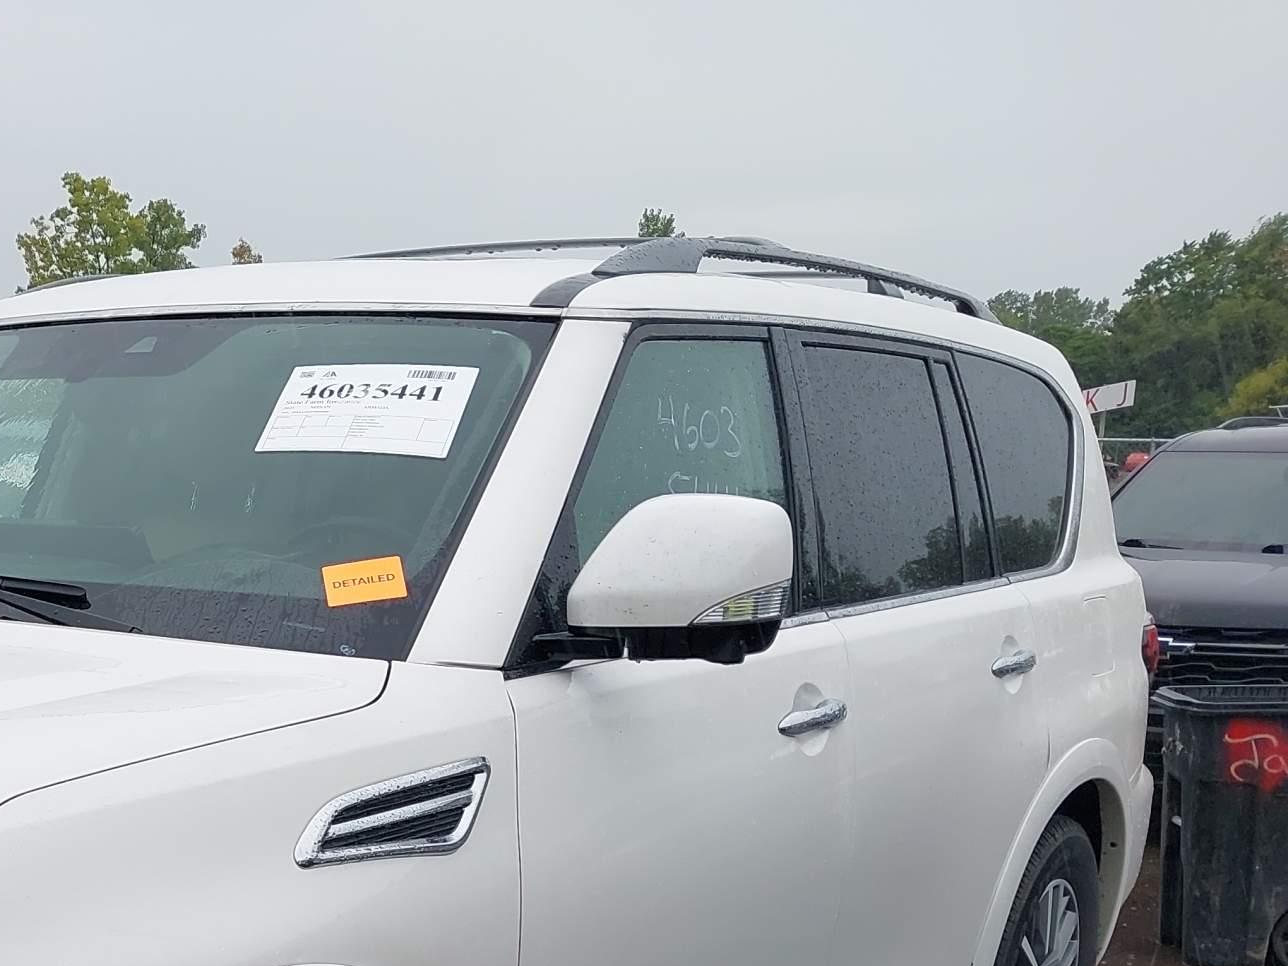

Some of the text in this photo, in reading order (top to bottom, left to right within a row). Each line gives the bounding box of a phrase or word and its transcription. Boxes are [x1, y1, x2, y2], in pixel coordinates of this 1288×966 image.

[300, 383, 444, 401] 46035441
[1086, 382, 1129, 412] K J
[657, 395, 742, 458] 4603
[331, 573, 396, 590] DETAILED
